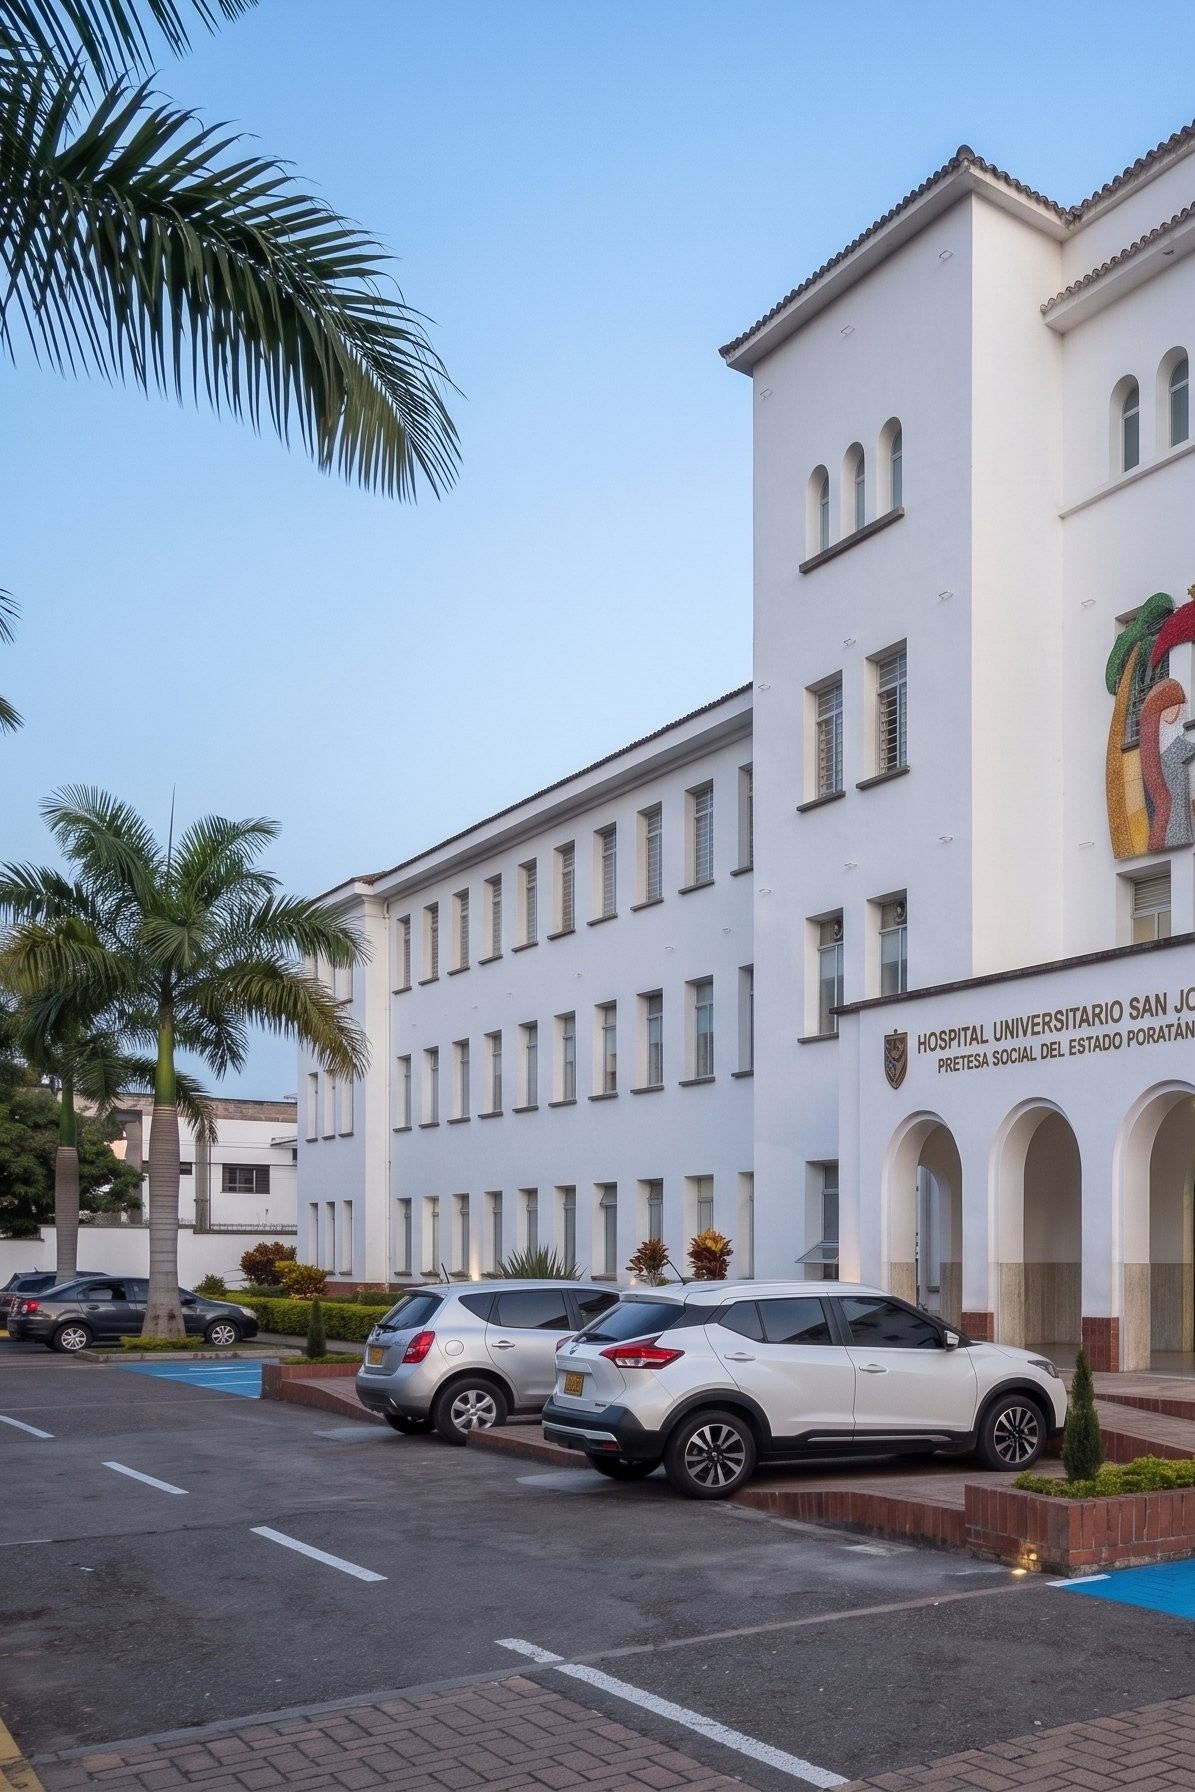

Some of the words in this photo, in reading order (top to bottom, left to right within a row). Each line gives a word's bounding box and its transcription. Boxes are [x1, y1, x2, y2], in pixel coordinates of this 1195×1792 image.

[917, 1023, 989, 1055] HOSPITAL
[993, 999, 1124, 1043] UNIVERSITARIO
[1128, 991, 1168, 1021] SAN
[937, 1051, 990, 1074] PRETESA
[992, 1045, 1038, 1067] SOCIAL
[1040, 1040, 1066, 1060] DEL
[1068, 1031, 1123, 1057] ESTADO
[1126, 1016, 1195, 1048] PORATÁN
